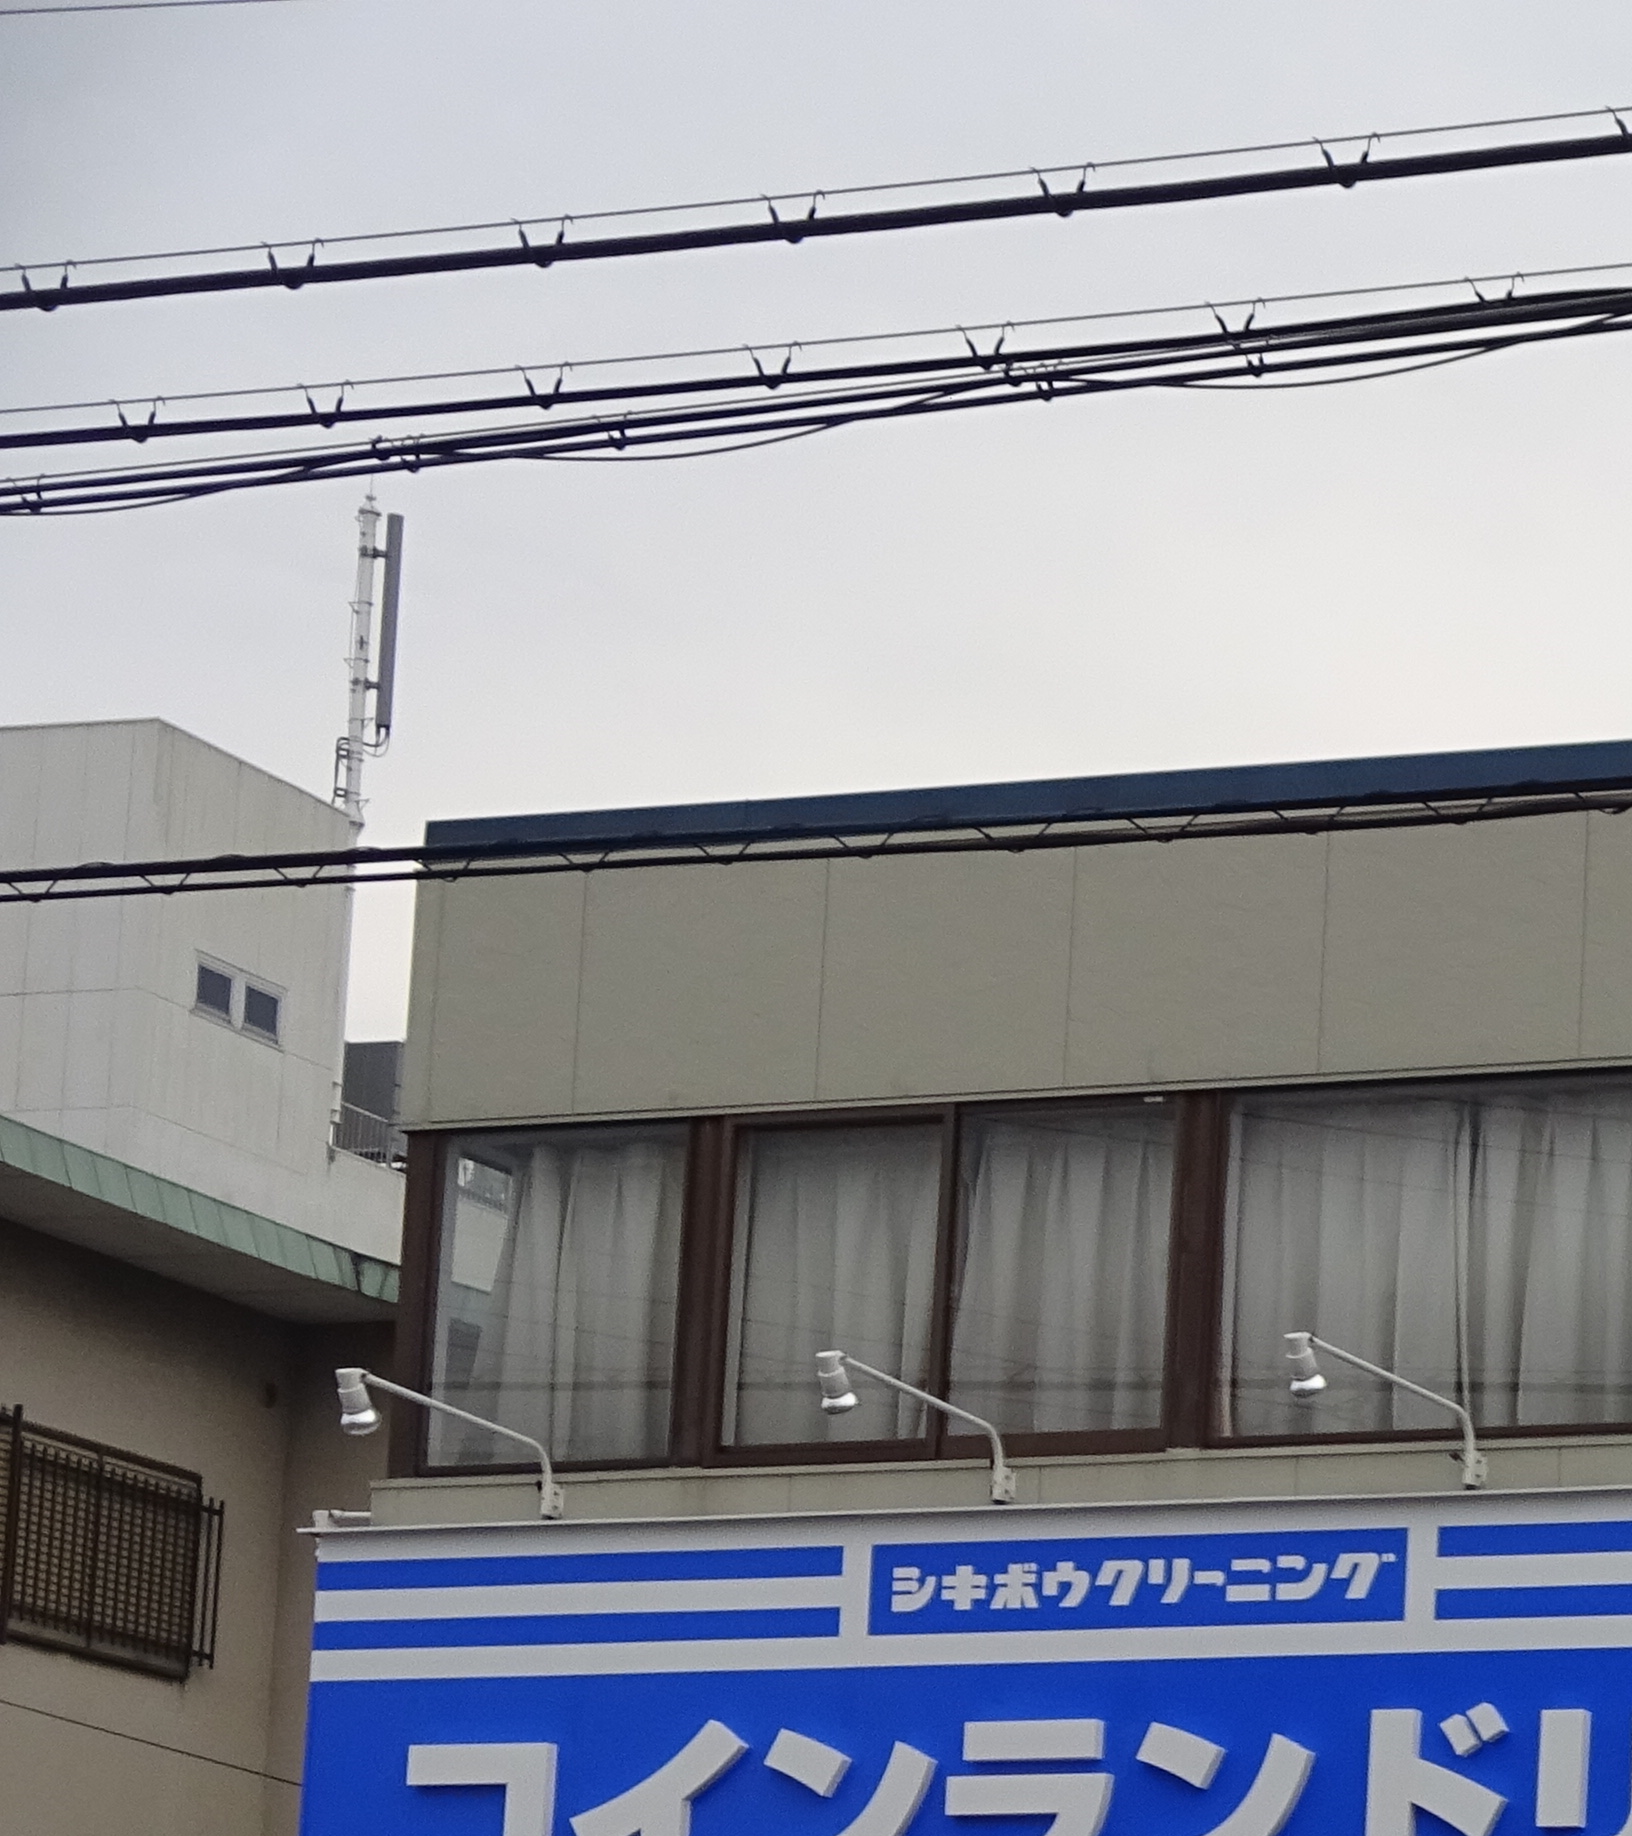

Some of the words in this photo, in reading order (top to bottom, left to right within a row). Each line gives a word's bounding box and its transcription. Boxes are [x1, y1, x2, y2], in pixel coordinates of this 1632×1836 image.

[890, 1550, 1397, 1613] シキボウクリーニング
